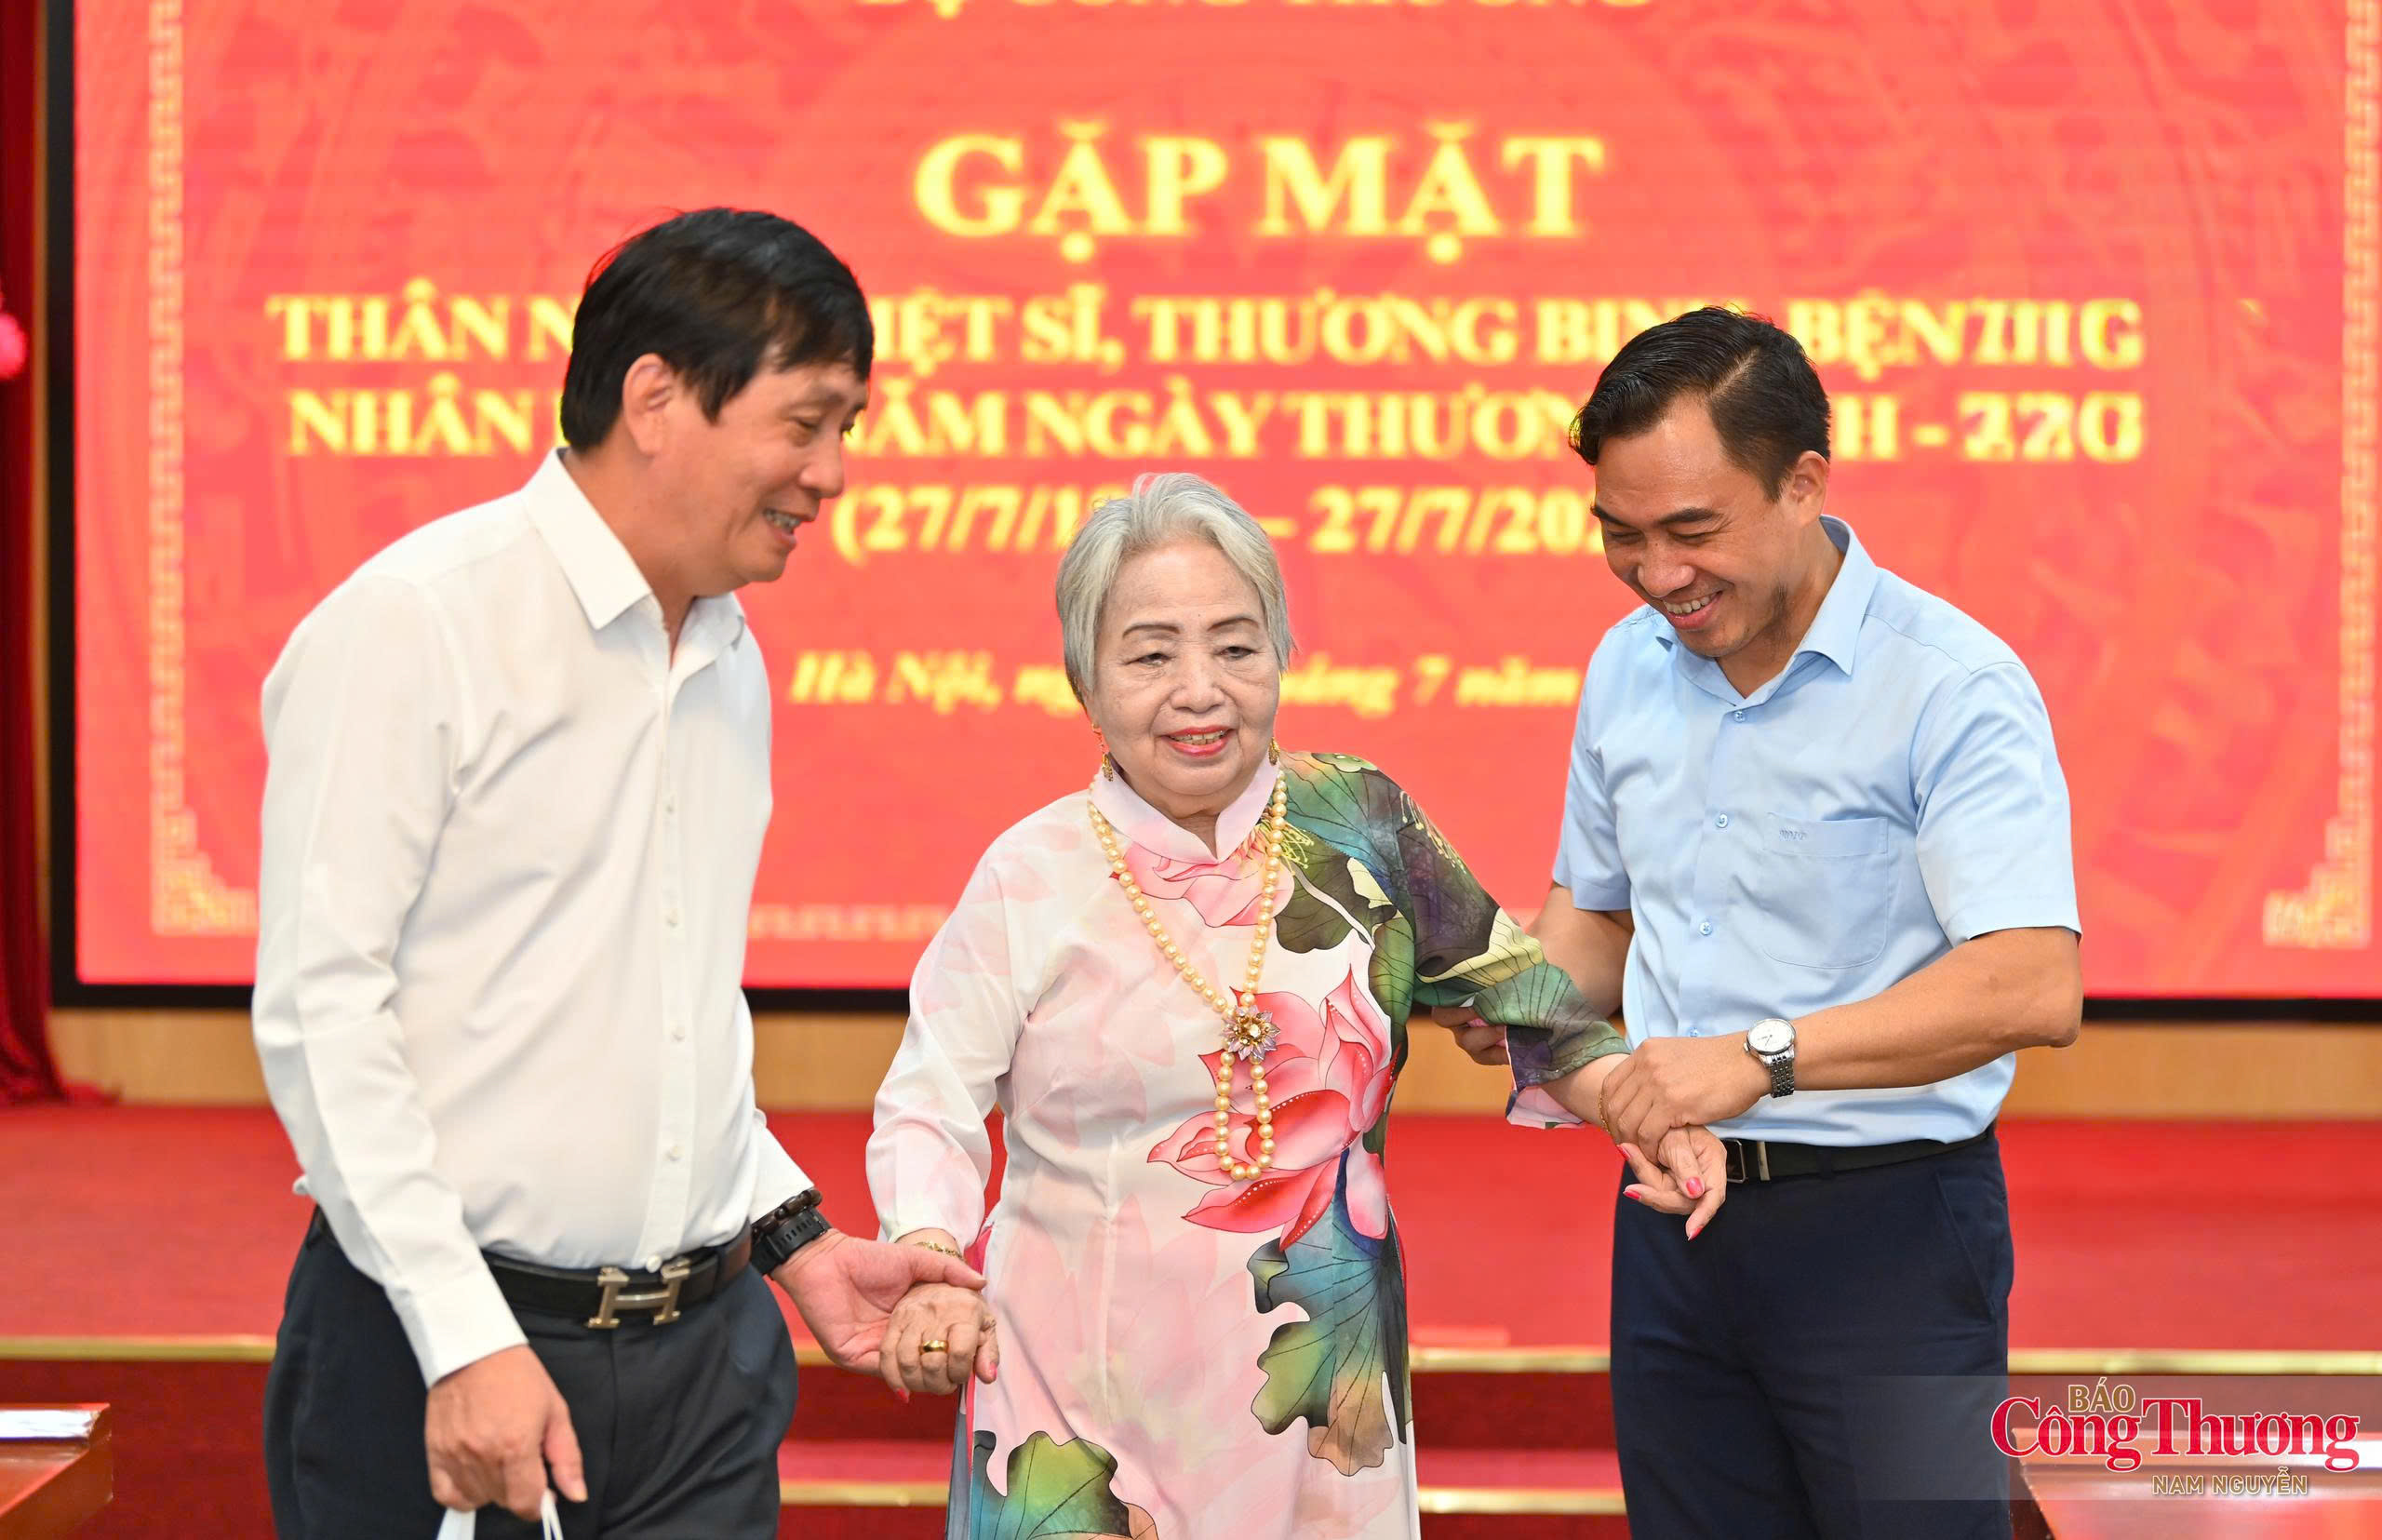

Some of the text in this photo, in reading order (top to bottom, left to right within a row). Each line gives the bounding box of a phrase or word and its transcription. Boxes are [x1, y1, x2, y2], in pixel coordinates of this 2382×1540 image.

[915, 119, 1605, 263] GẶP MẶT
[265, 279, 509, 361] THÂN
[870, 288, 1014, 377] IỆT
[1130, 287, 1518, 366] THƯƠNG
[289, 374, 533, 456] NHÂN
[1025, 374, 1274, 459] NGÀY
[1280, 383, 1579, 461] THƯƠN
[789, 649, 875, 704] Hà
[1414, 654, 1449, 704] 7
